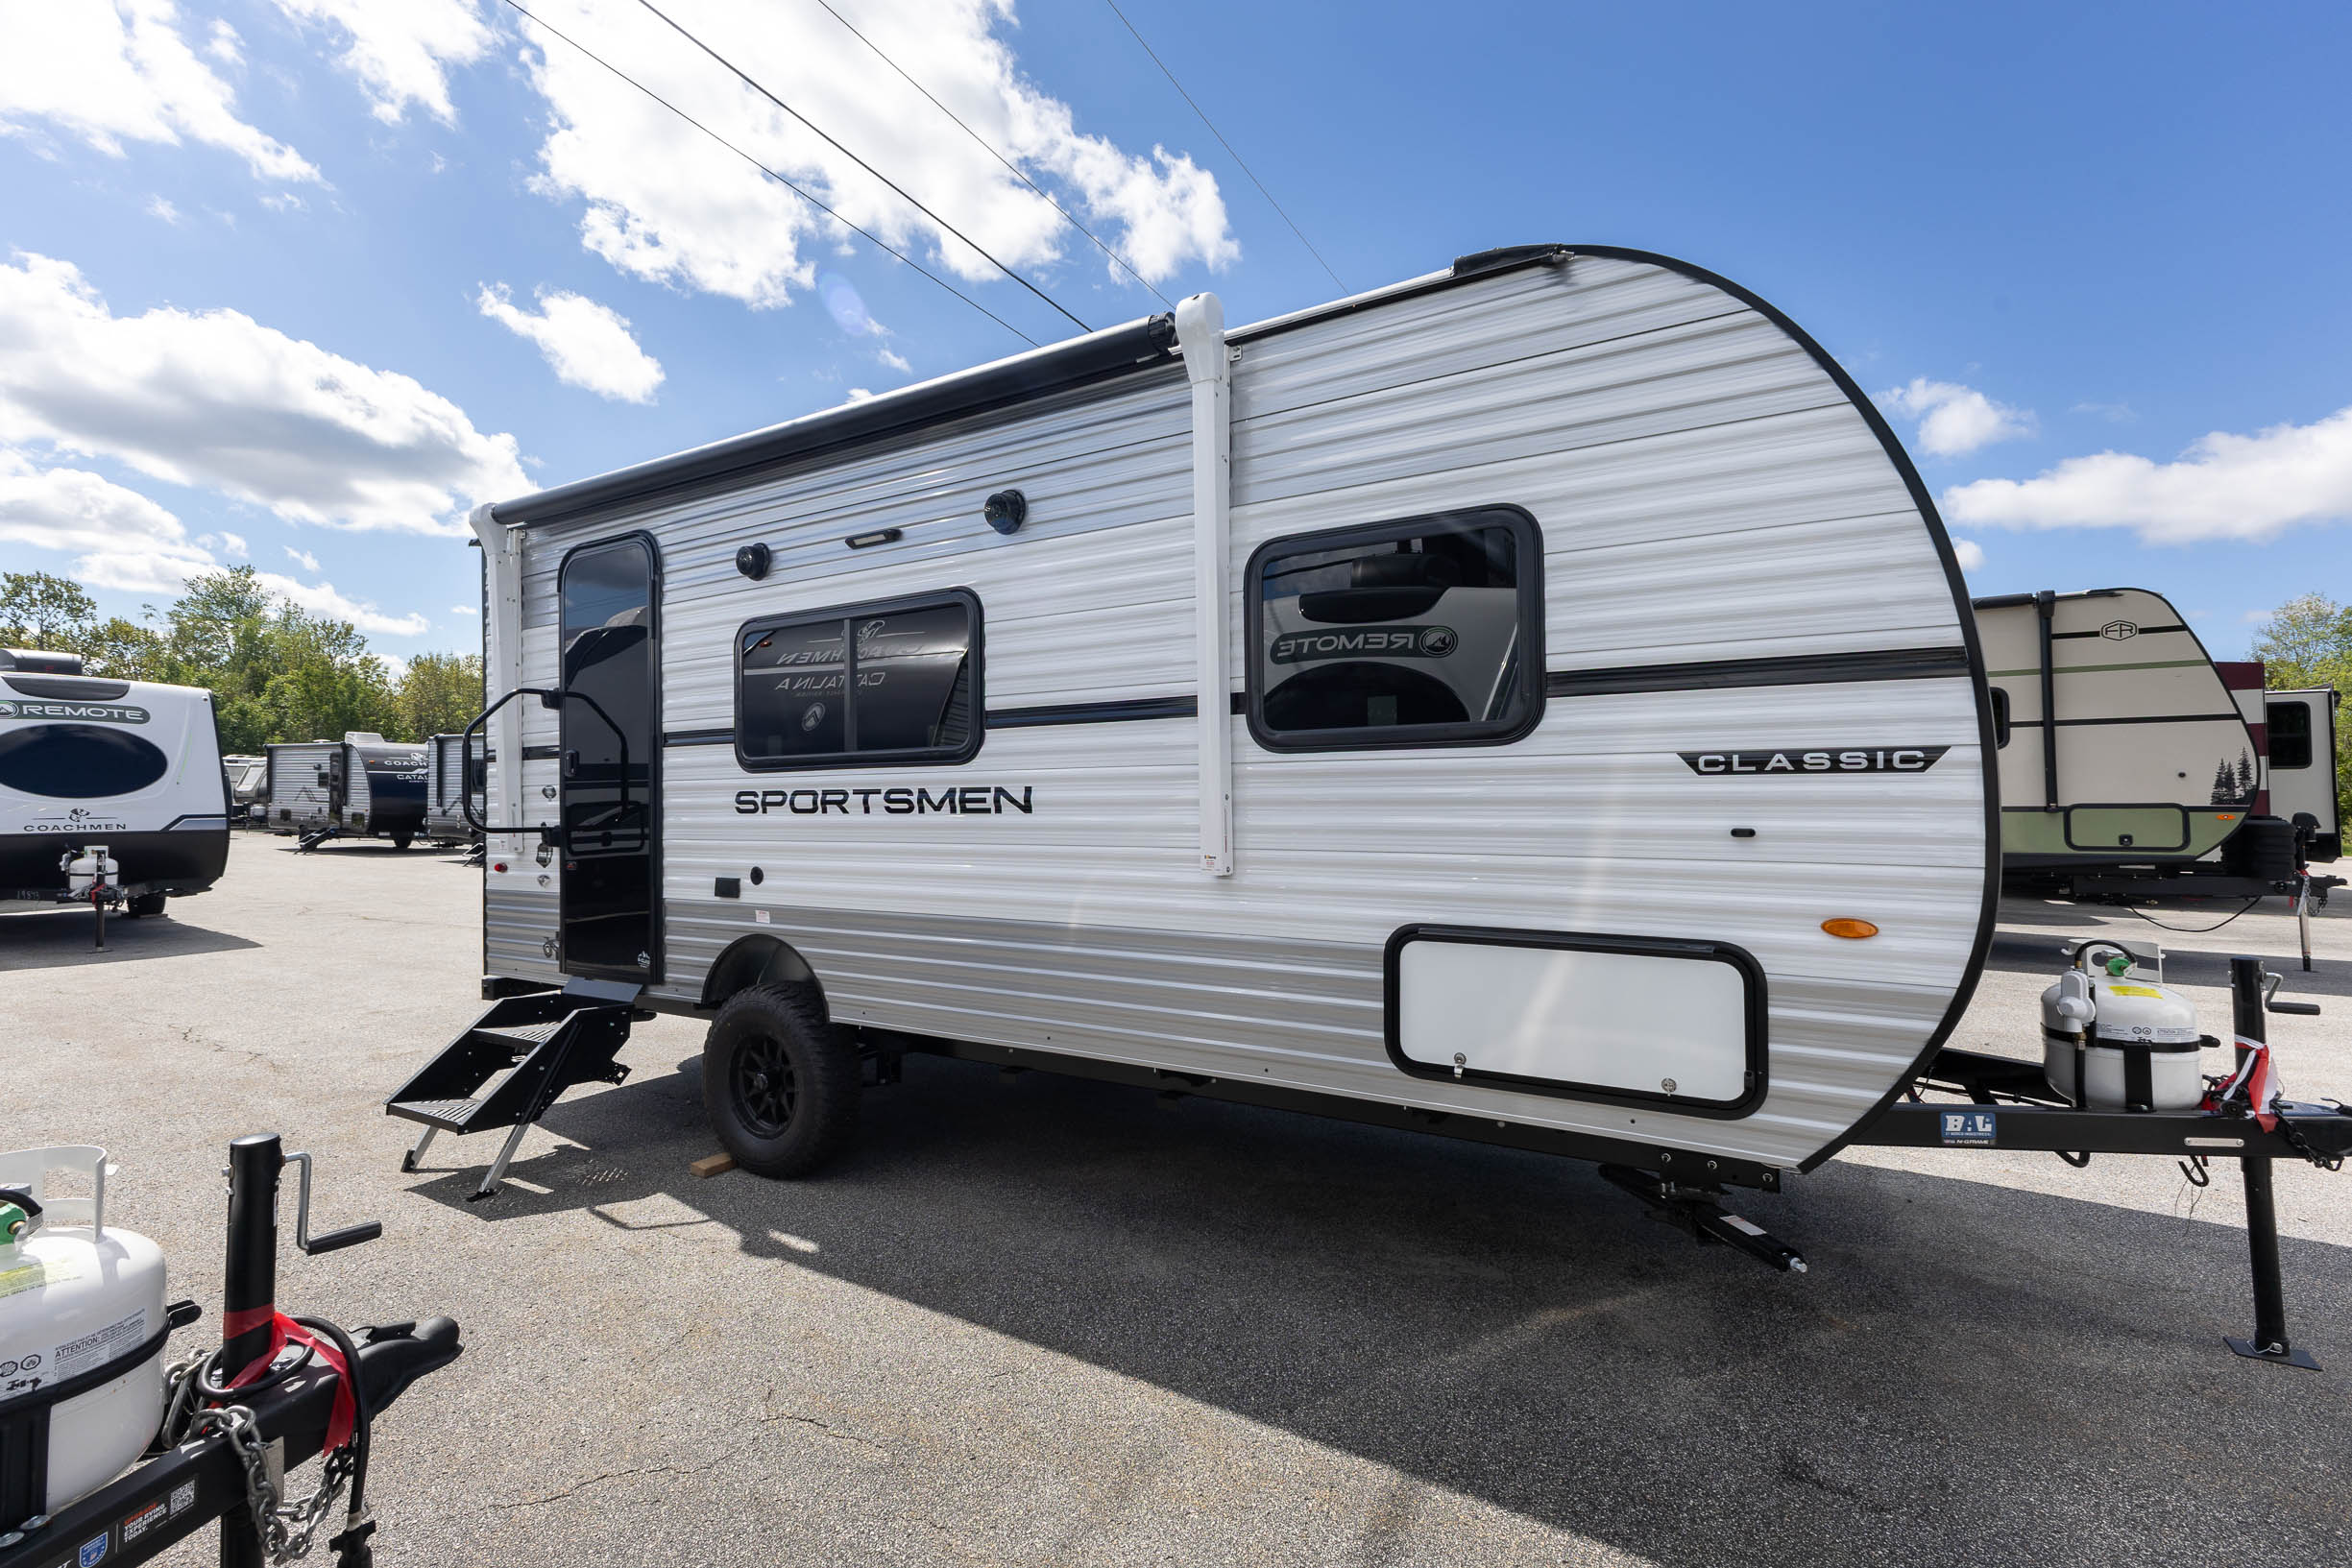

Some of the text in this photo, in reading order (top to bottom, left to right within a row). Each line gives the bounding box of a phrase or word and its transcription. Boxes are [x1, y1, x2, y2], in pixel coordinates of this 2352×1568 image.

[22, 704, 144, 720] REMOTE
[1698, 751, 1925, 772] CLASSIC
[735, 785, 1032, 814] SPORTSMEN
[23, 823, 127, 832] COACHMEN
[55, 1336, 101, 1359] ATTENTION:
[124, 1516, 143, 1531] YOUR
[144, 1503, 165, 1520] RVING
[124, 1507, 167, 1536] EXPERIENCE
[124, 1525, 148, 1543] TODAY.
